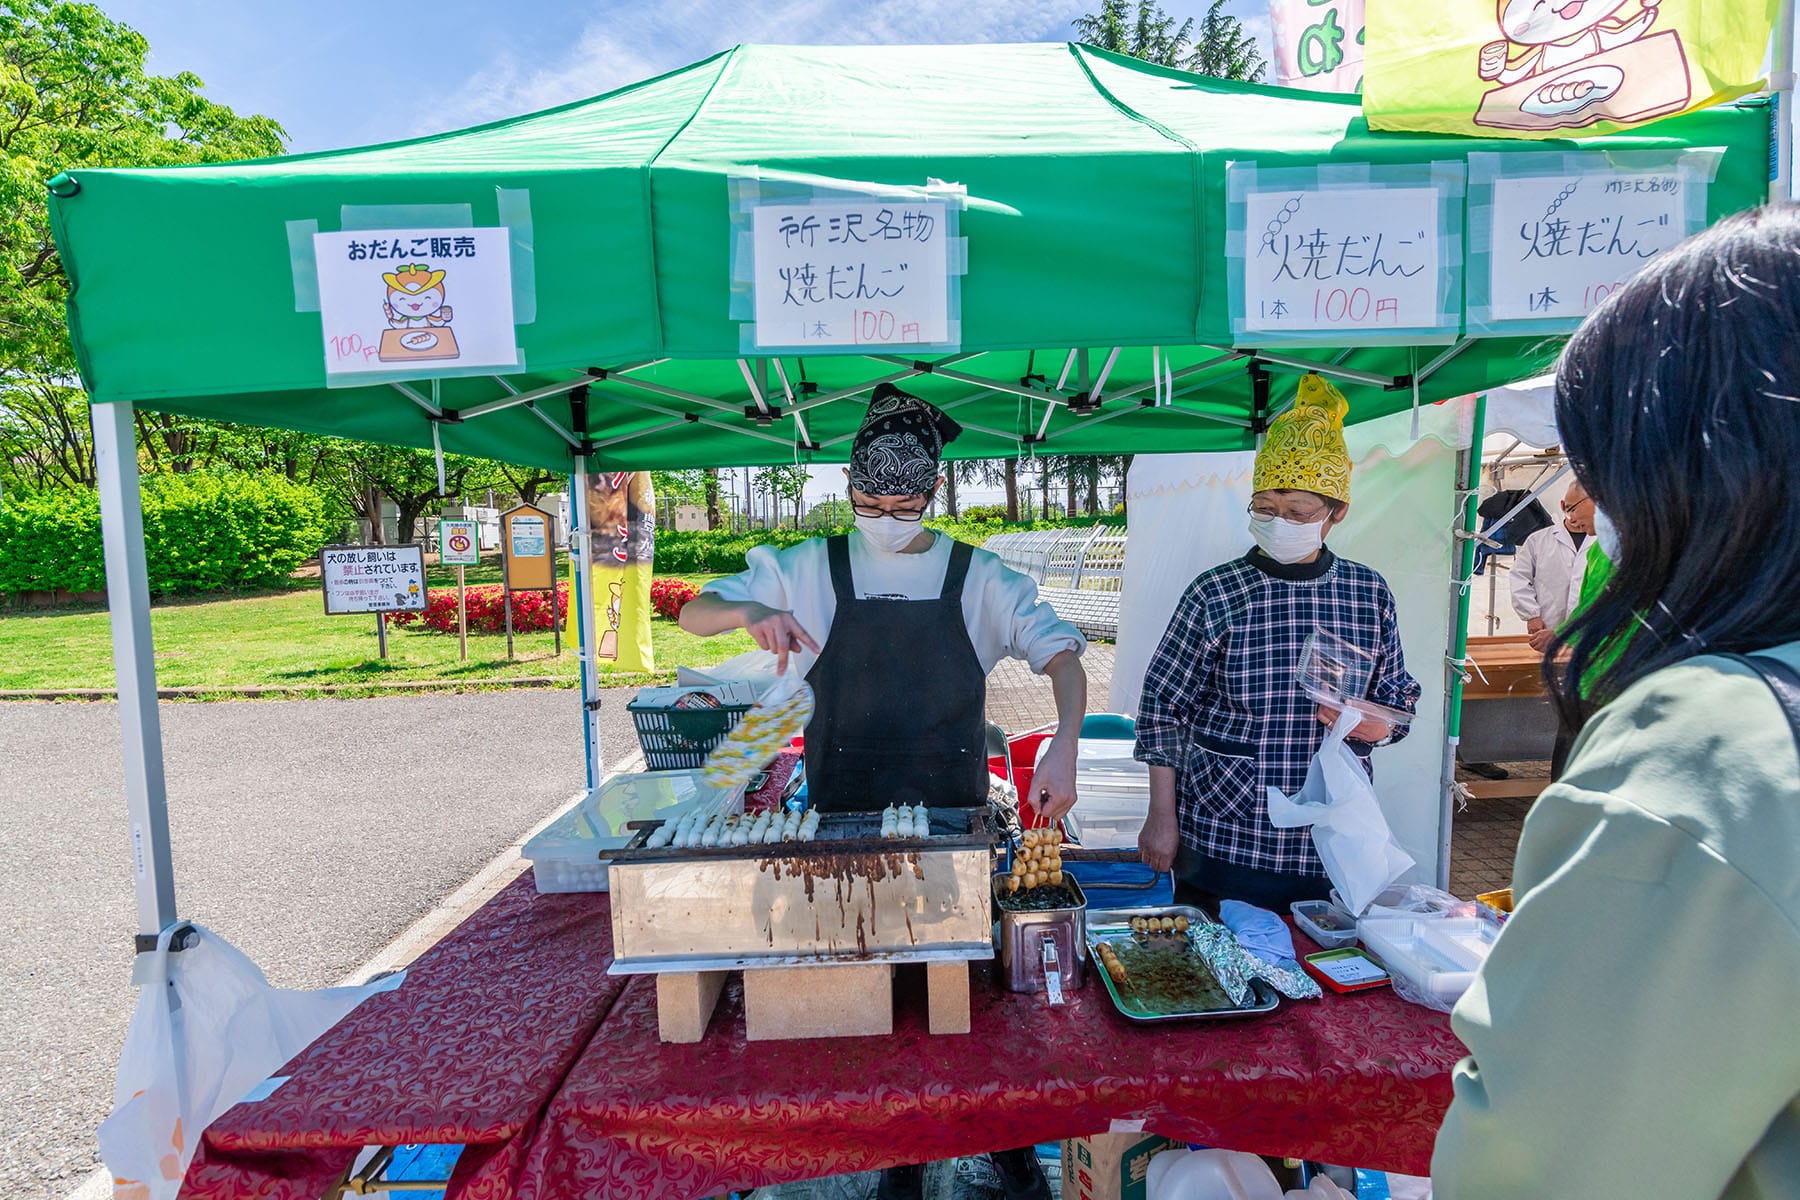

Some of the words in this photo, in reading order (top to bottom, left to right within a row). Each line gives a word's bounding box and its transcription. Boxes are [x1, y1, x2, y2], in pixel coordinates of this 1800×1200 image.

[778, 208, 935, 248] 所沢名物
[1519, 213, 1669, 262] 焼だんご
[348, 236, 476, 261] おだんご販売
[1270, 228, 1425, 282] 焼だんご
[778, 262, 908, 306] 焼だんご
[1529, 286, 1560, 312] 1本
[1583, 281, 1625, 309] 10
[1261, 298, 1289, 320] 1本
[1314, 287, 1398, 324] 100円
[803, 320, 831, 339] 1本
[854, 308, 920, 344] 100円
[330, 333, 380, 363] 100円
[327, 551, 397, 565] 犬の放し飼いは
[343, 562, 419, 576] 禁止されています。
